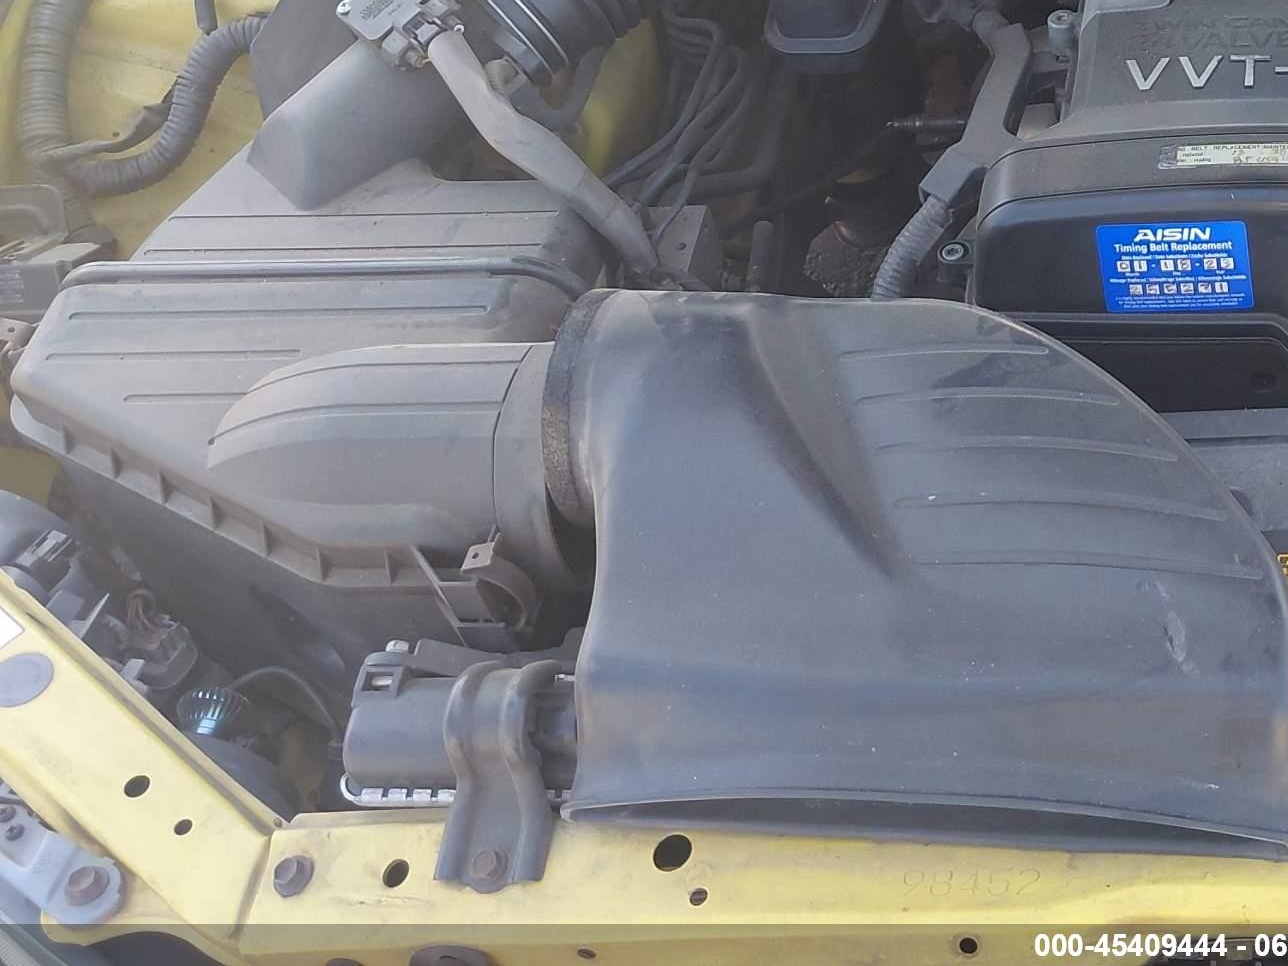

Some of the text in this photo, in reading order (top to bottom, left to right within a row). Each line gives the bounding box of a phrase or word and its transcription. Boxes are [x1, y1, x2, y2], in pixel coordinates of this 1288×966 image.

[1133, 227, 1211, 242] AISIN
[1114, 241, 1232, 254] Timing Belt Replacement
